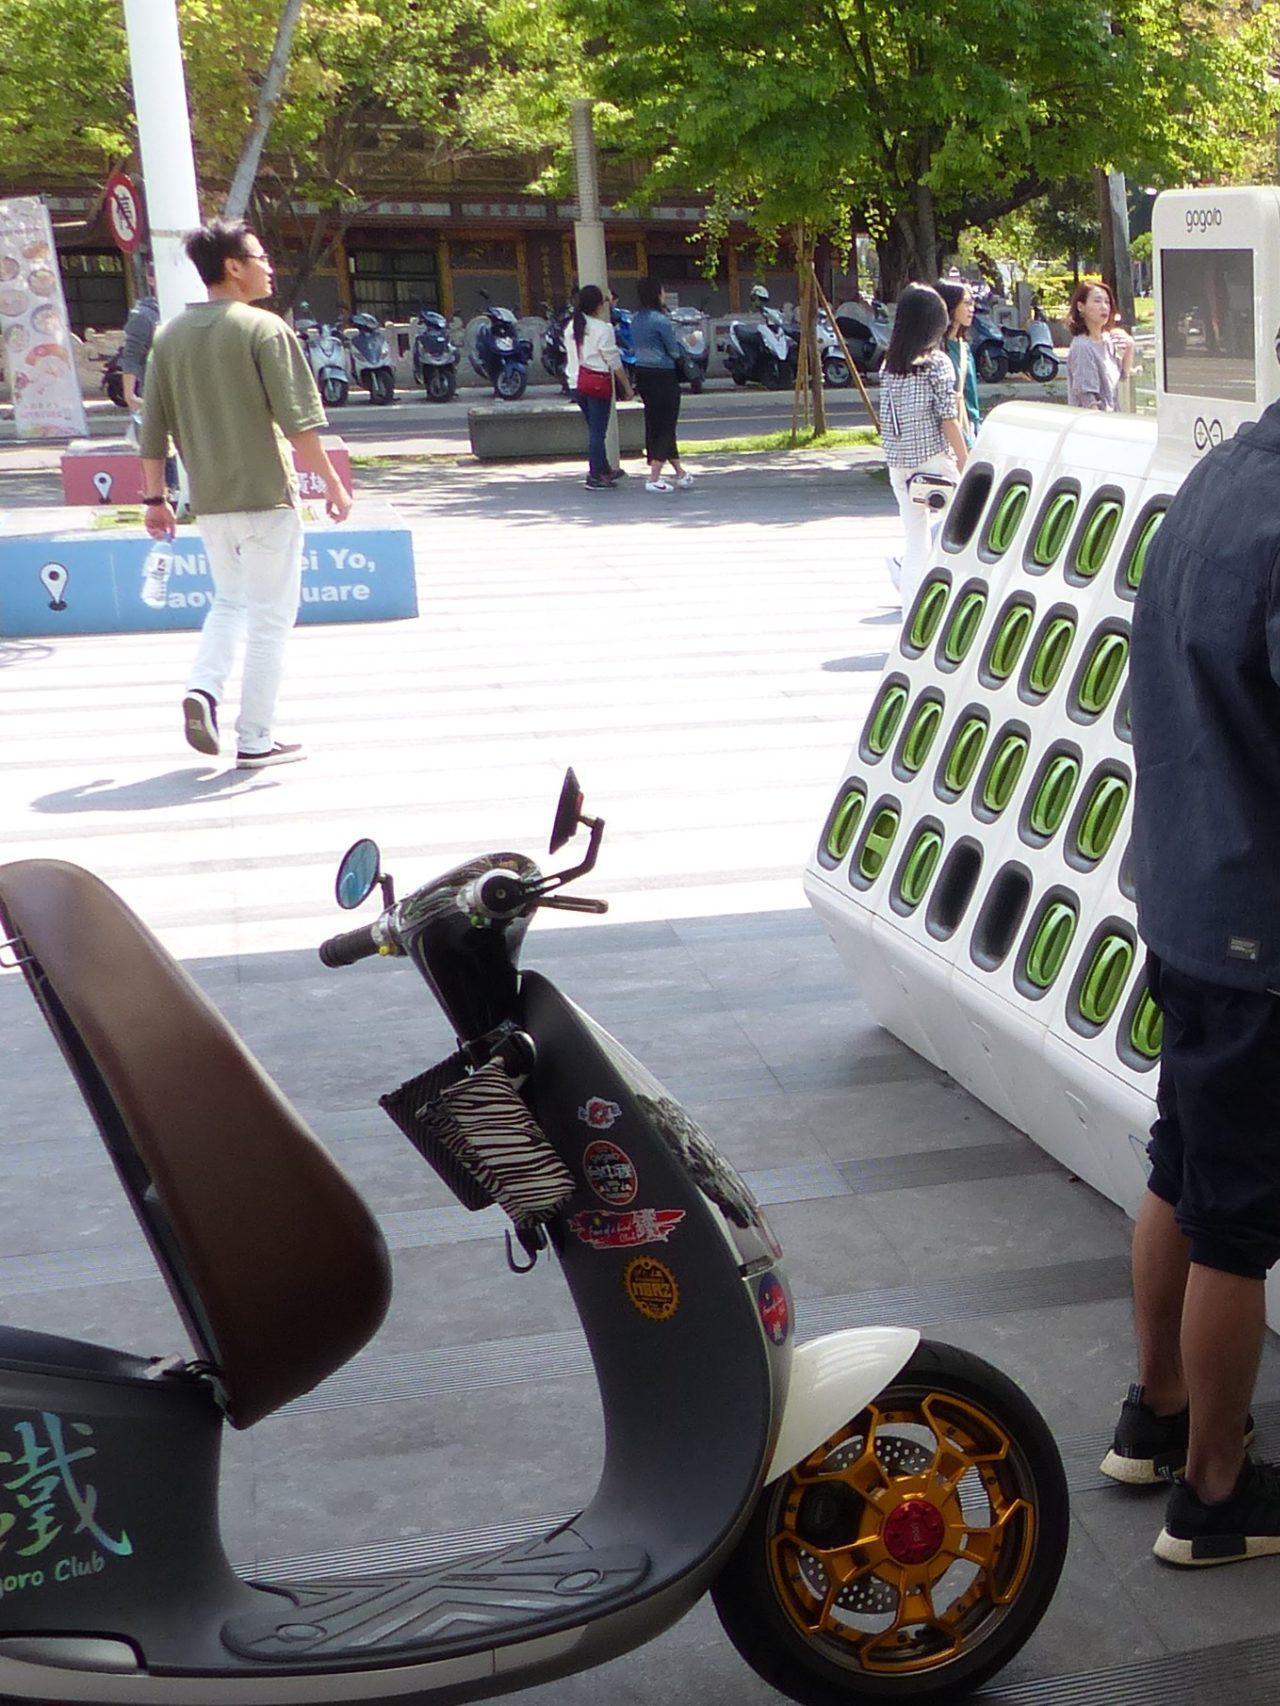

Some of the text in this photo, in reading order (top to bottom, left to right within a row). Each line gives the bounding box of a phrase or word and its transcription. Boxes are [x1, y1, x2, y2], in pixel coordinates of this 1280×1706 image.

[1185, 207, 1222, 233] gogoro
[326, 548, 376, 573] Yo,
[302, 584, 371, 603] uare
[54, 1550, 105, 1583] Club
